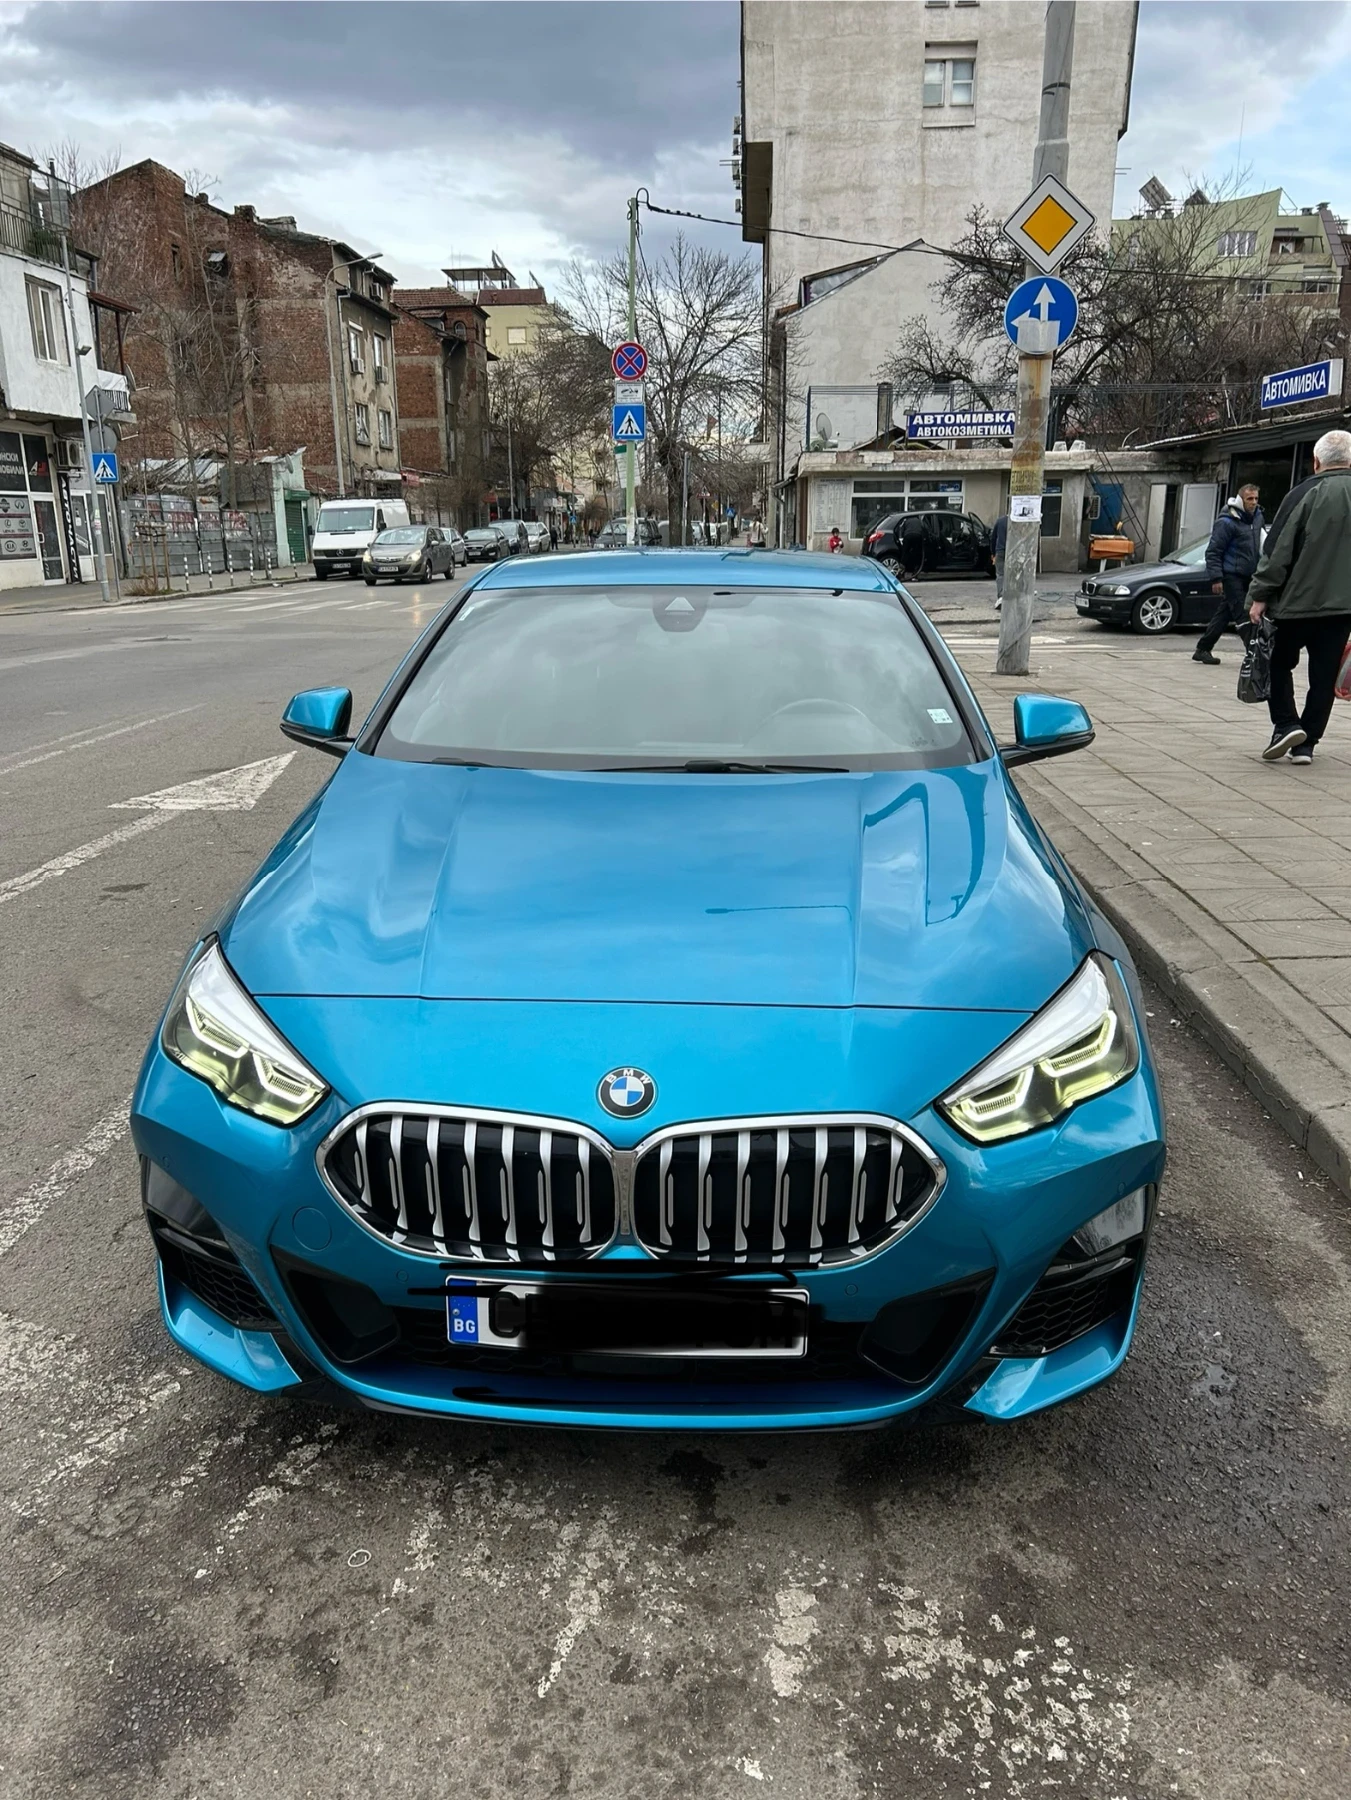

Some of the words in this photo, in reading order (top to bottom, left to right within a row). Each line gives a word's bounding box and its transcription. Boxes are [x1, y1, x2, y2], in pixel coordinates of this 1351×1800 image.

[1264, 369, 1326, 402] АВТОМИВКА
[912, 412, 1016, 425] АВТОМИВКА
[916, 425, 1012, 437] АВТОКОЗМЕТИКА
[61, 476, 79, 579] АВТОЧАСТИ
[605, 1069, 652, 1085] BMW
[453, 1317, 477, 1335] BG
